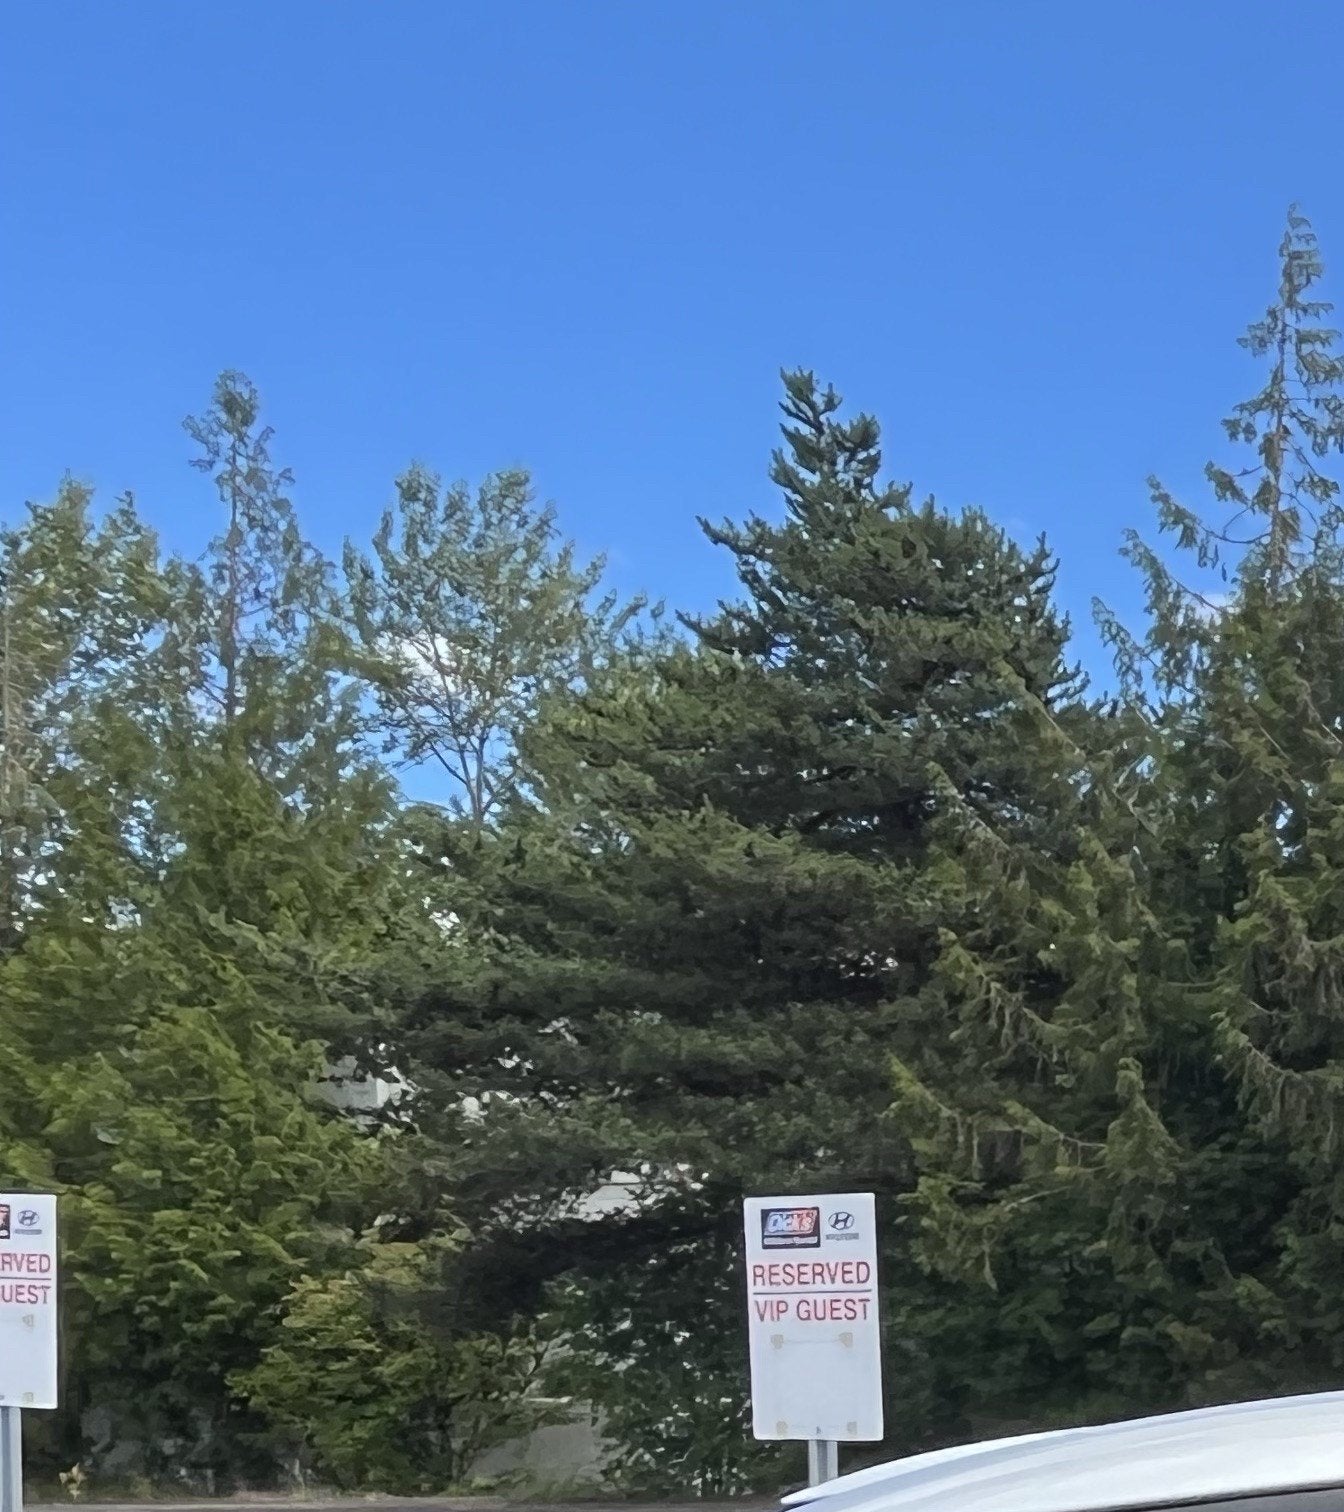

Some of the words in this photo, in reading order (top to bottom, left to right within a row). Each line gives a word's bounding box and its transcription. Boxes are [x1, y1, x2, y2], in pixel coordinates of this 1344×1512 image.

[752, 1261, 871, 1287] RESERVED
[754, 1299, 789, 1323] VIP
[796, 1298, 871, 1321] GUEST
